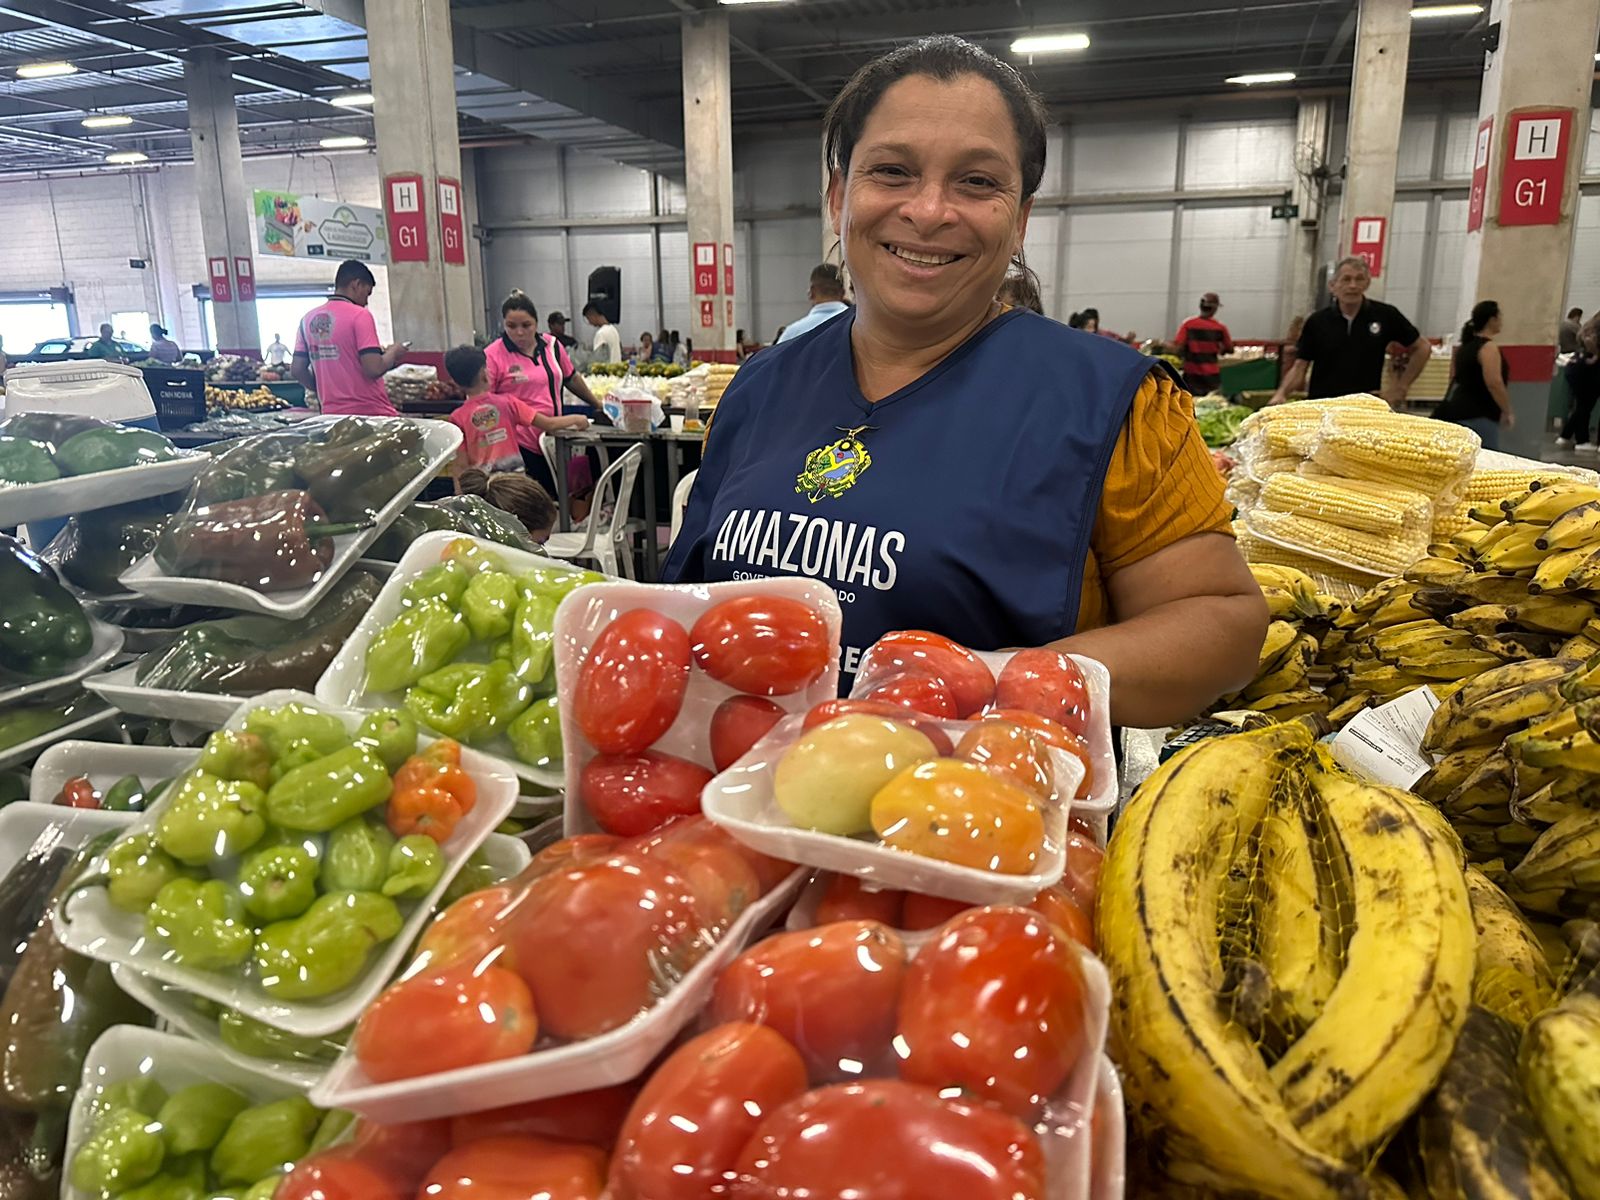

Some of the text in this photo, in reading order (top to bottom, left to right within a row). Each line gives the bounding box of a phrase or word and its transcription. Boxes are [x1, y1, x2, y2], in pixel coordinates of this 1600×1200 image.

[1528, 125, 1548, 154] H
[400, 186, 412, 208] H
[444, 188, 454, 210] H
[1515, 178, 1547, 207] G1
[399, 225, 418, 248] G1
[444, 227, 458, 249] G1
[215, 282, 227, 296] G1
[241, 282, 252, 295] G1
[699, 271, 713, 288] G1
[712, 509, 906, 591] AMAZONAS
